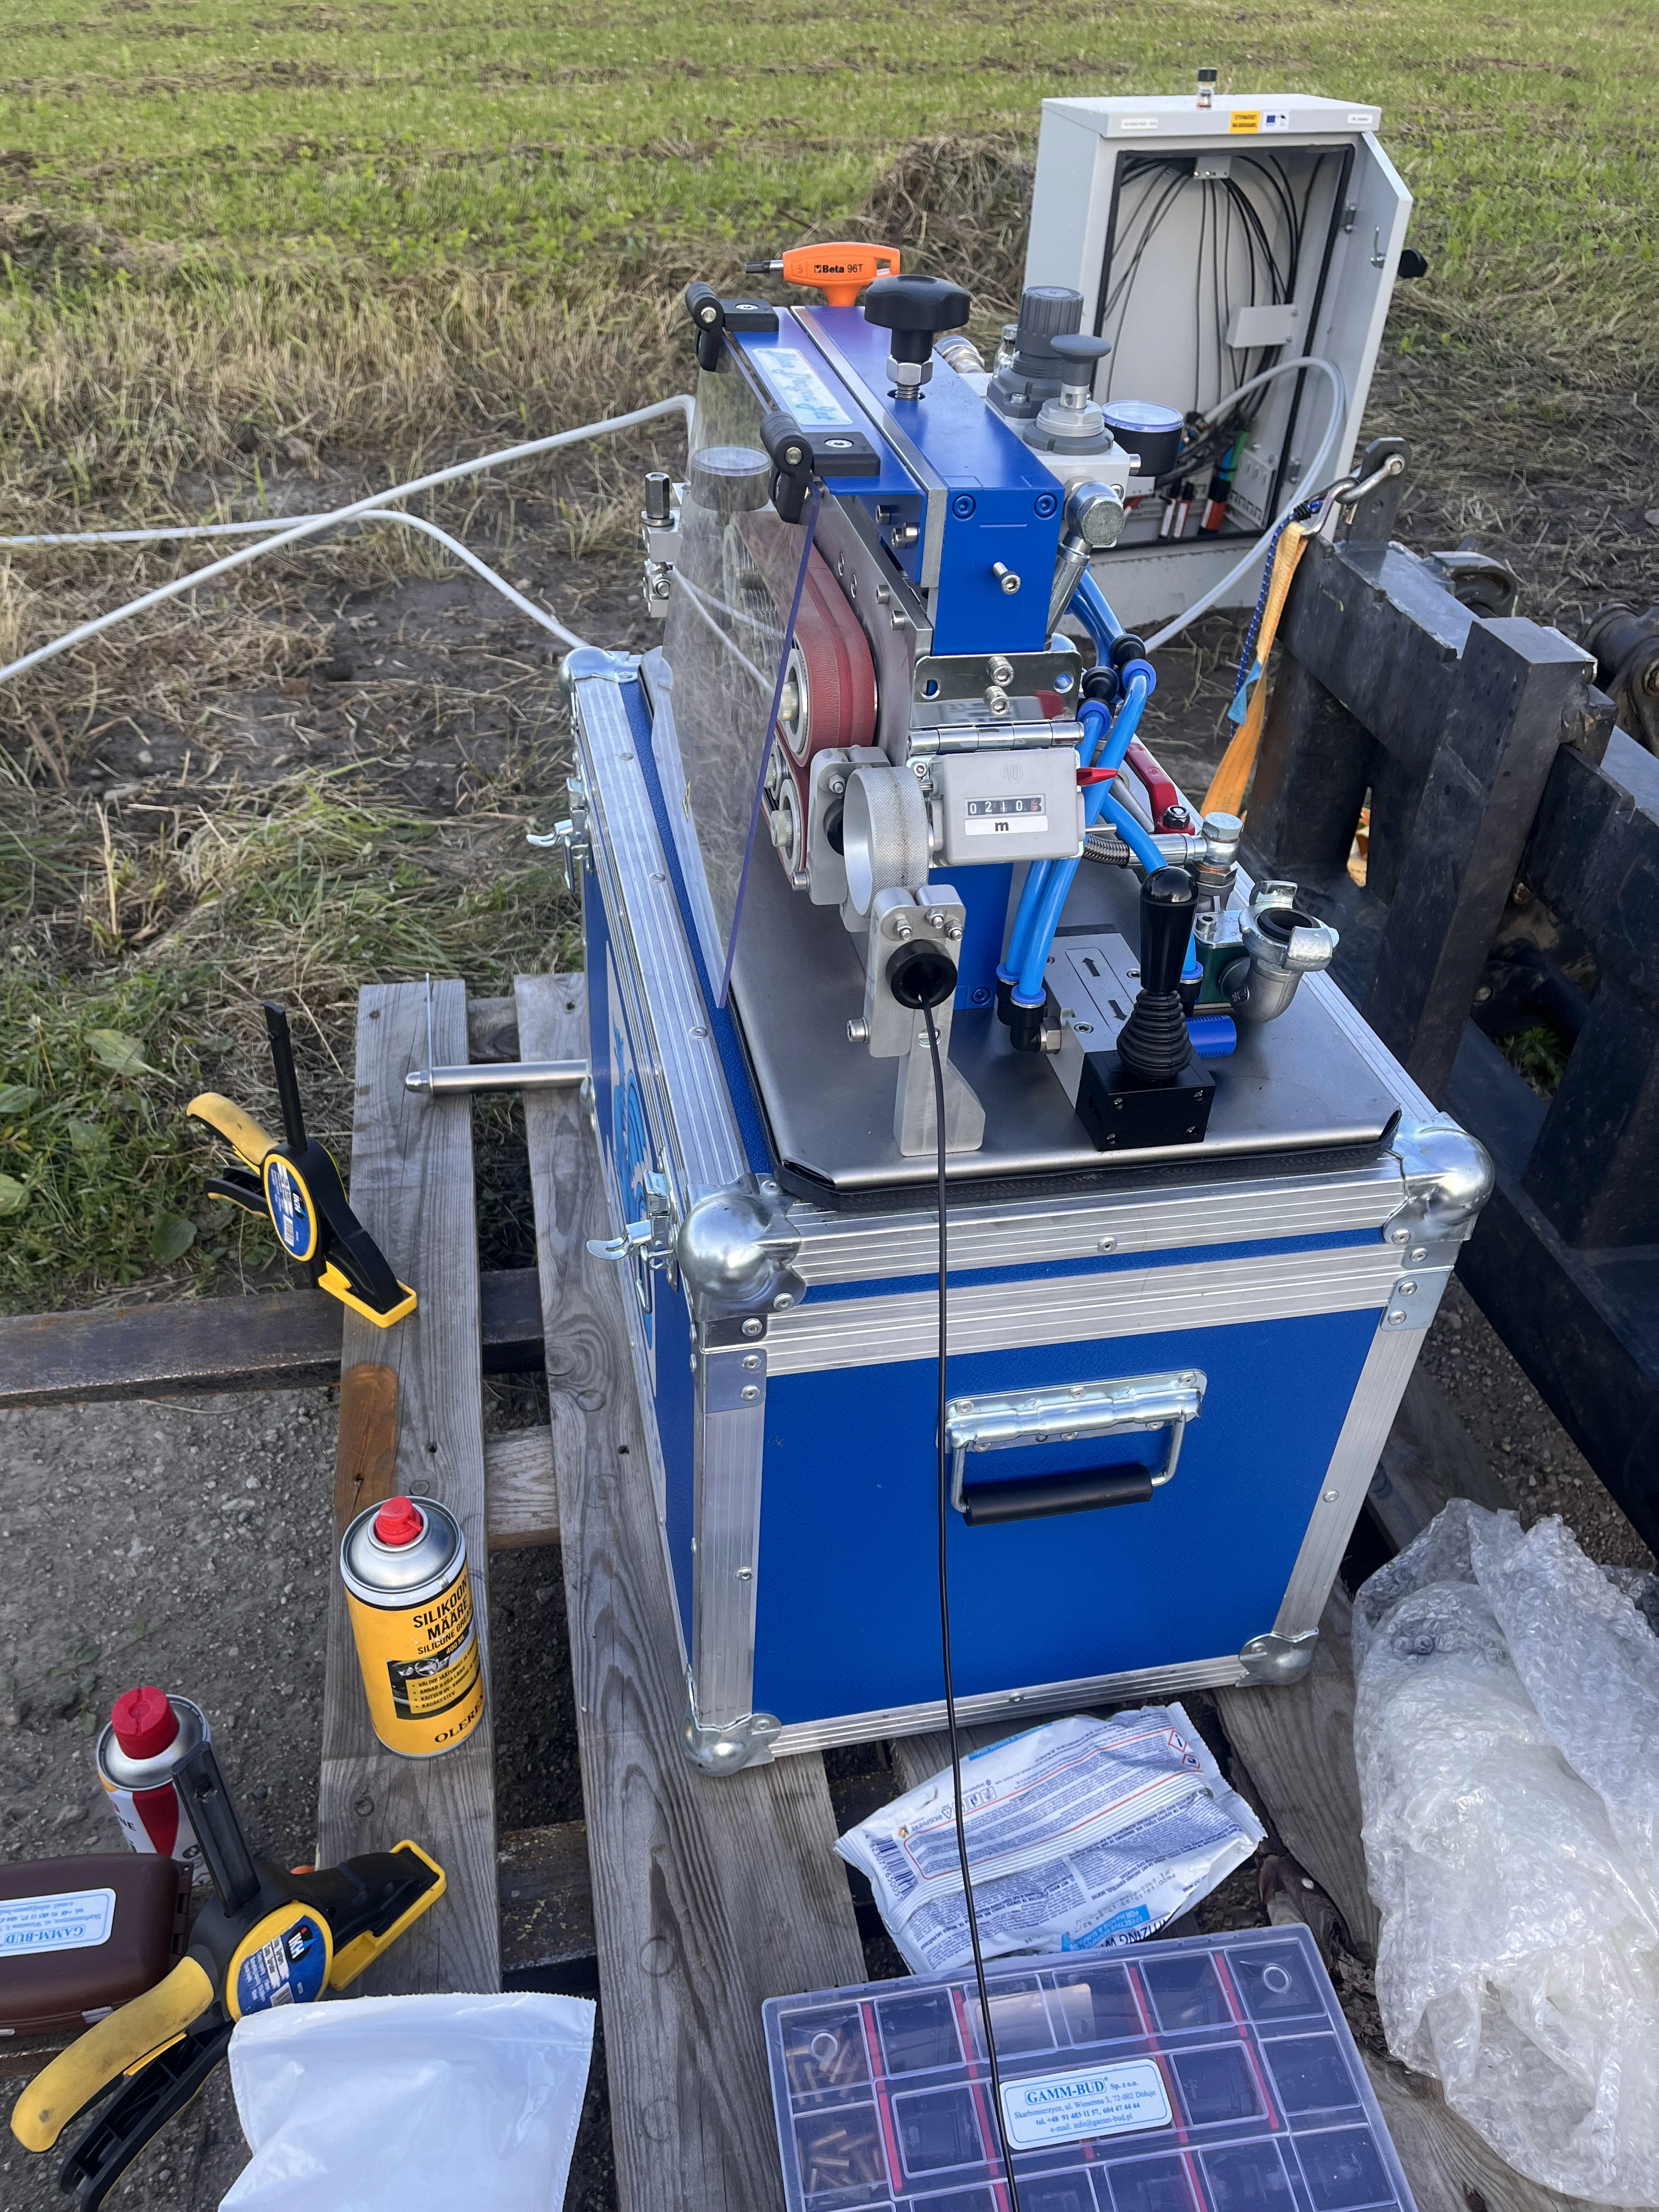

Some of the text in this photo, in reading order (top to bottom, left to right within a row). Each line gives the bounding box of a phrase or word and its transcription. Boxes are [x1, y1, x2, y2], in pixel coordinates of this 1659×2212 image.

[823, 264, 863, 273] Beta 96T
[995, 822, 1009, 831] m
[413, 1573, 469, 1628] SILIKOON
[427, 1594, 467, 1640] MÄÄRE
[910, 1814, 943, 1832] BIOSPHERE
[1110, 1916, 1143, 1931] EFFECTIVE
[1125, 1909, 1139, 1919] FOR
[289, 1932, 304, 1959] IKH
[1014, 2106, 1064, 2119] Skarbimierzyce,
[1074, 2099, 1104, 2109] Wiosenna
[1113, 2092, 1133, 2102] 72-002
[1051, 2113, 1133, 2134] e-mail: info@gamm-bud.pl
